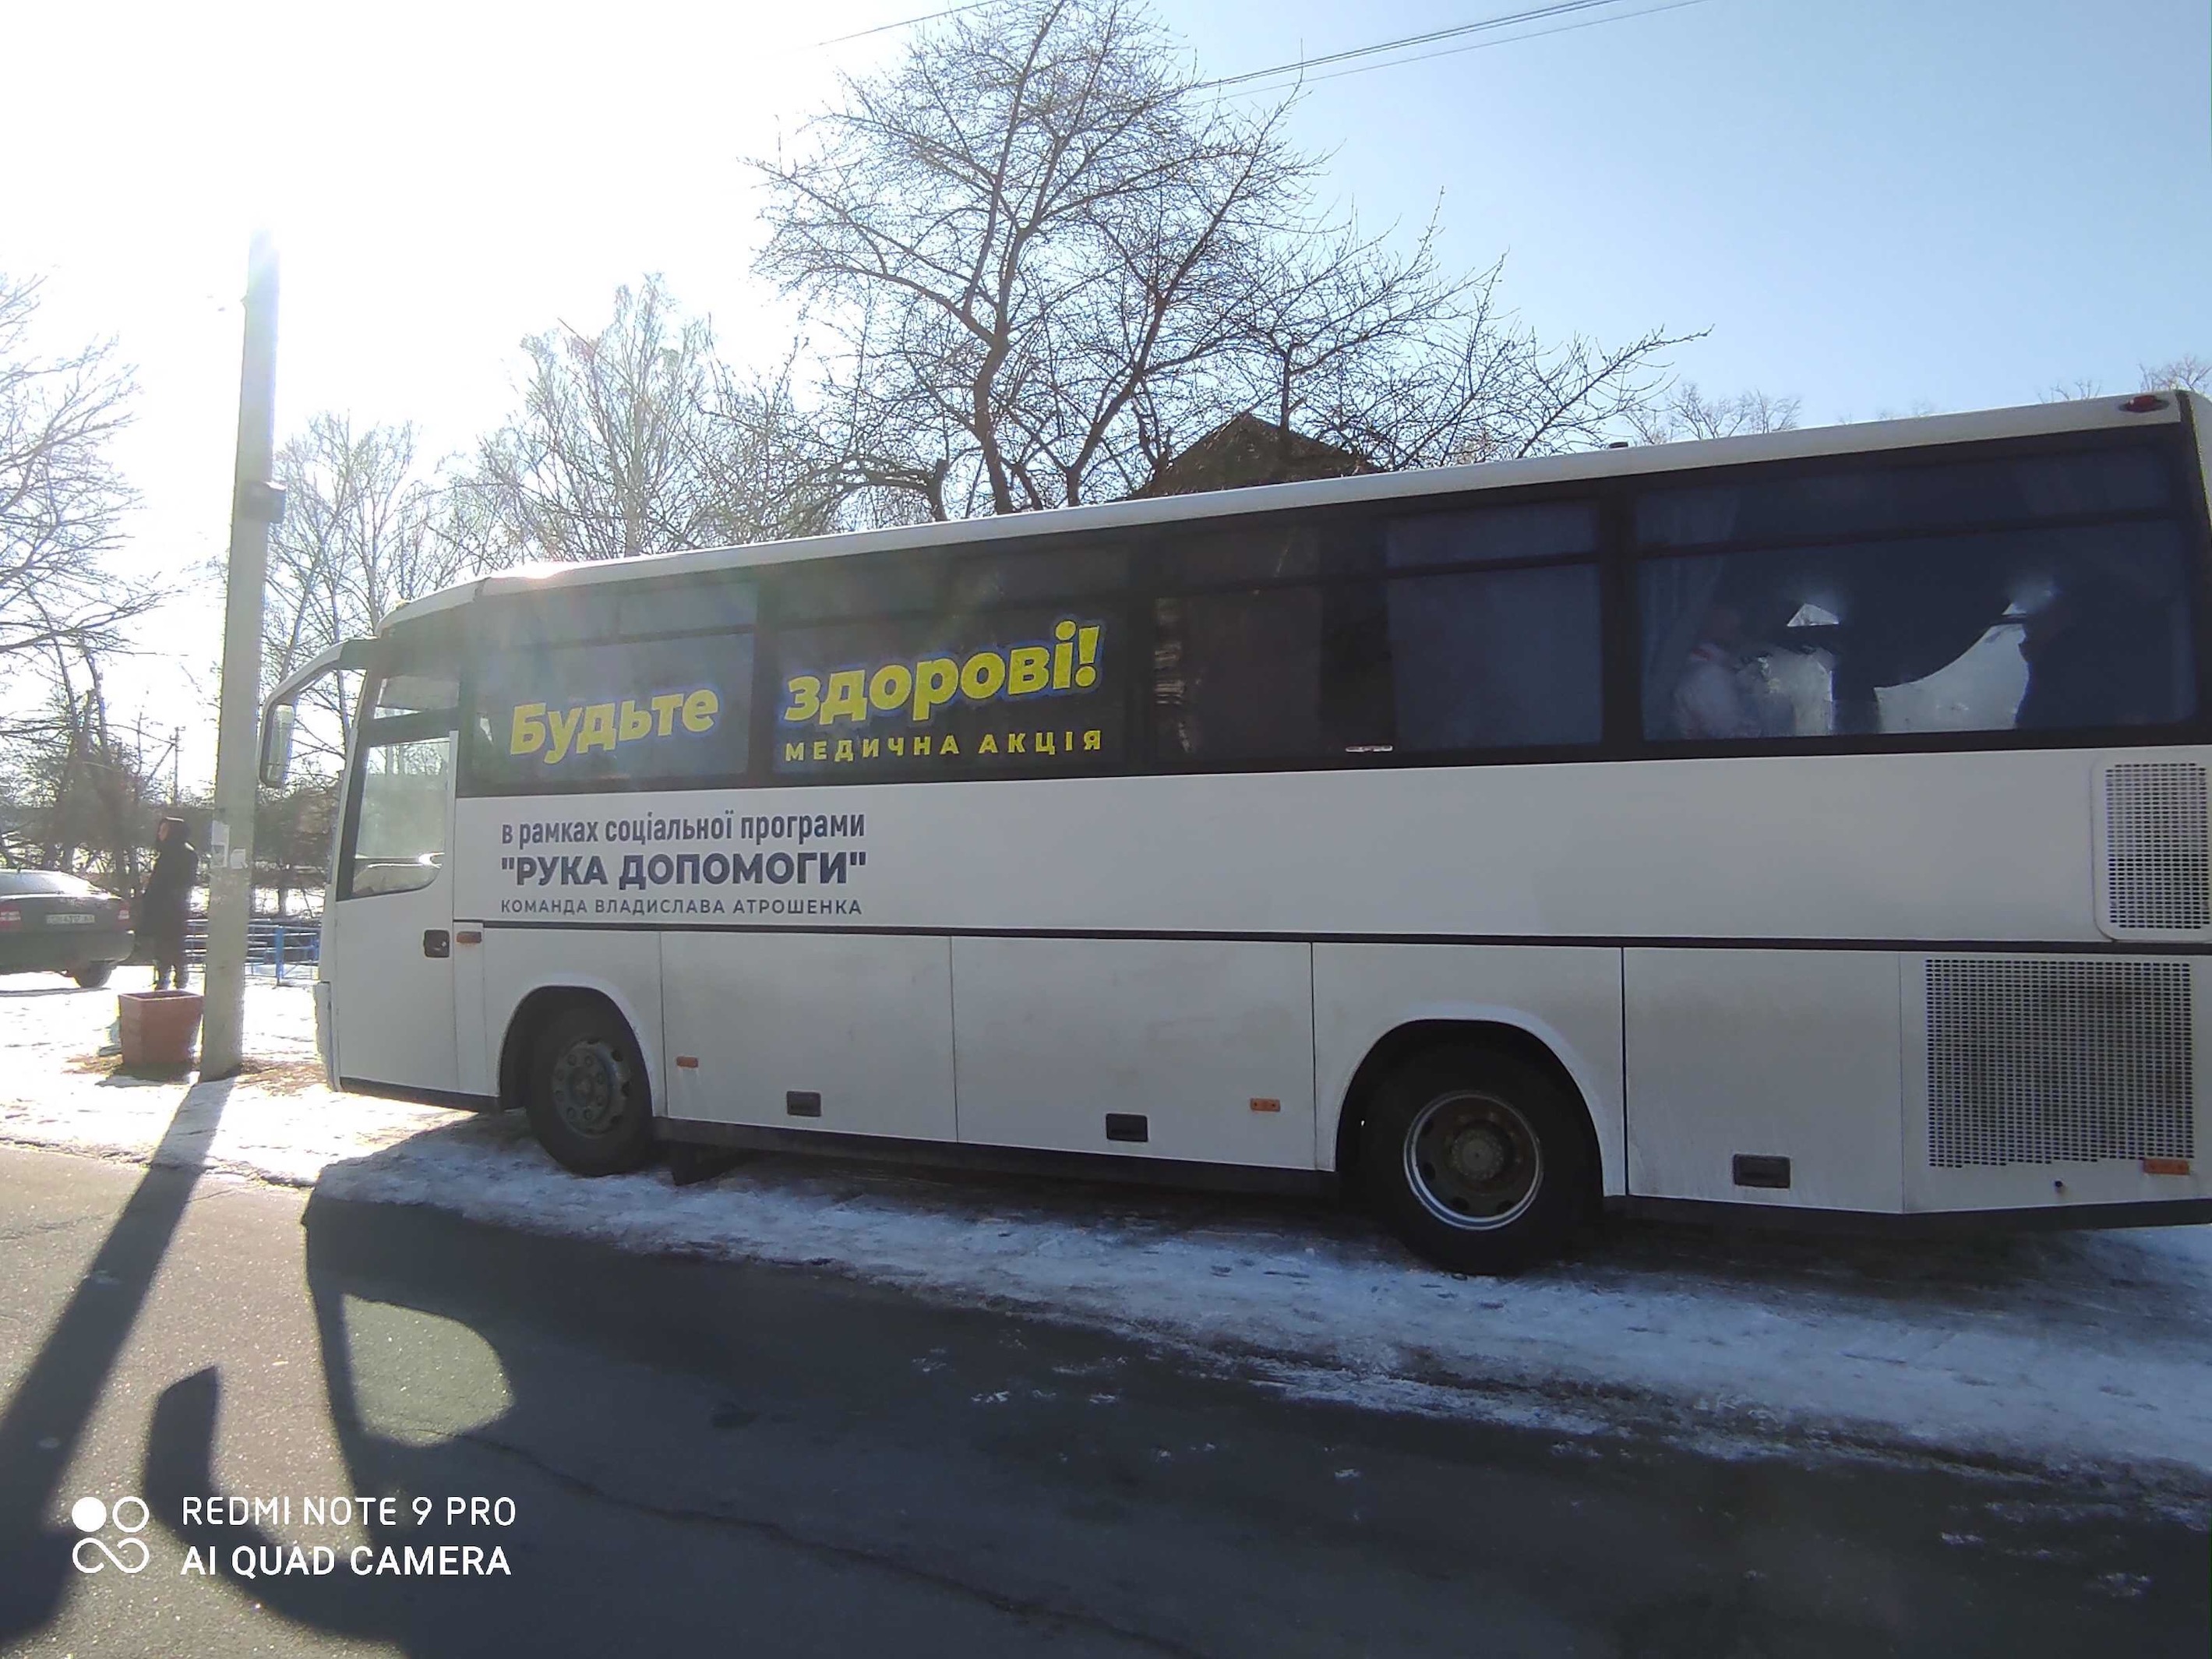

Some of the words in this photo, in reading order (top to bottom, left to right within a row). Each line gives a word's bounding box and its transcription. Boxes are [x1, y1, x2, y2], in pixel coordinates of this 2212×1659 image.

[510, 687, 721, 764] Будьте
[784, 620, 1101, 725] здорові!
[785, 735, 959, 763] МЕДИЧНА
[979, 729, 1102, 756] АКЦІЯ
[501, 824, 513, 844] в
[520, 821, 599, 850] рамках
[605, 810, 733, 845] соціальної
[740, 813, 866, 845] програми
[501, 855, 608, 886] "РУКА
[619, 852, 867, 891] ДОПОМОГИ"
[501, 898, 588, 915] КОМАНДА
[594, 898, 726, 916] ВЛАДИСЛАВА
[732, 898, 863, 916] АТРОШЕНКА
